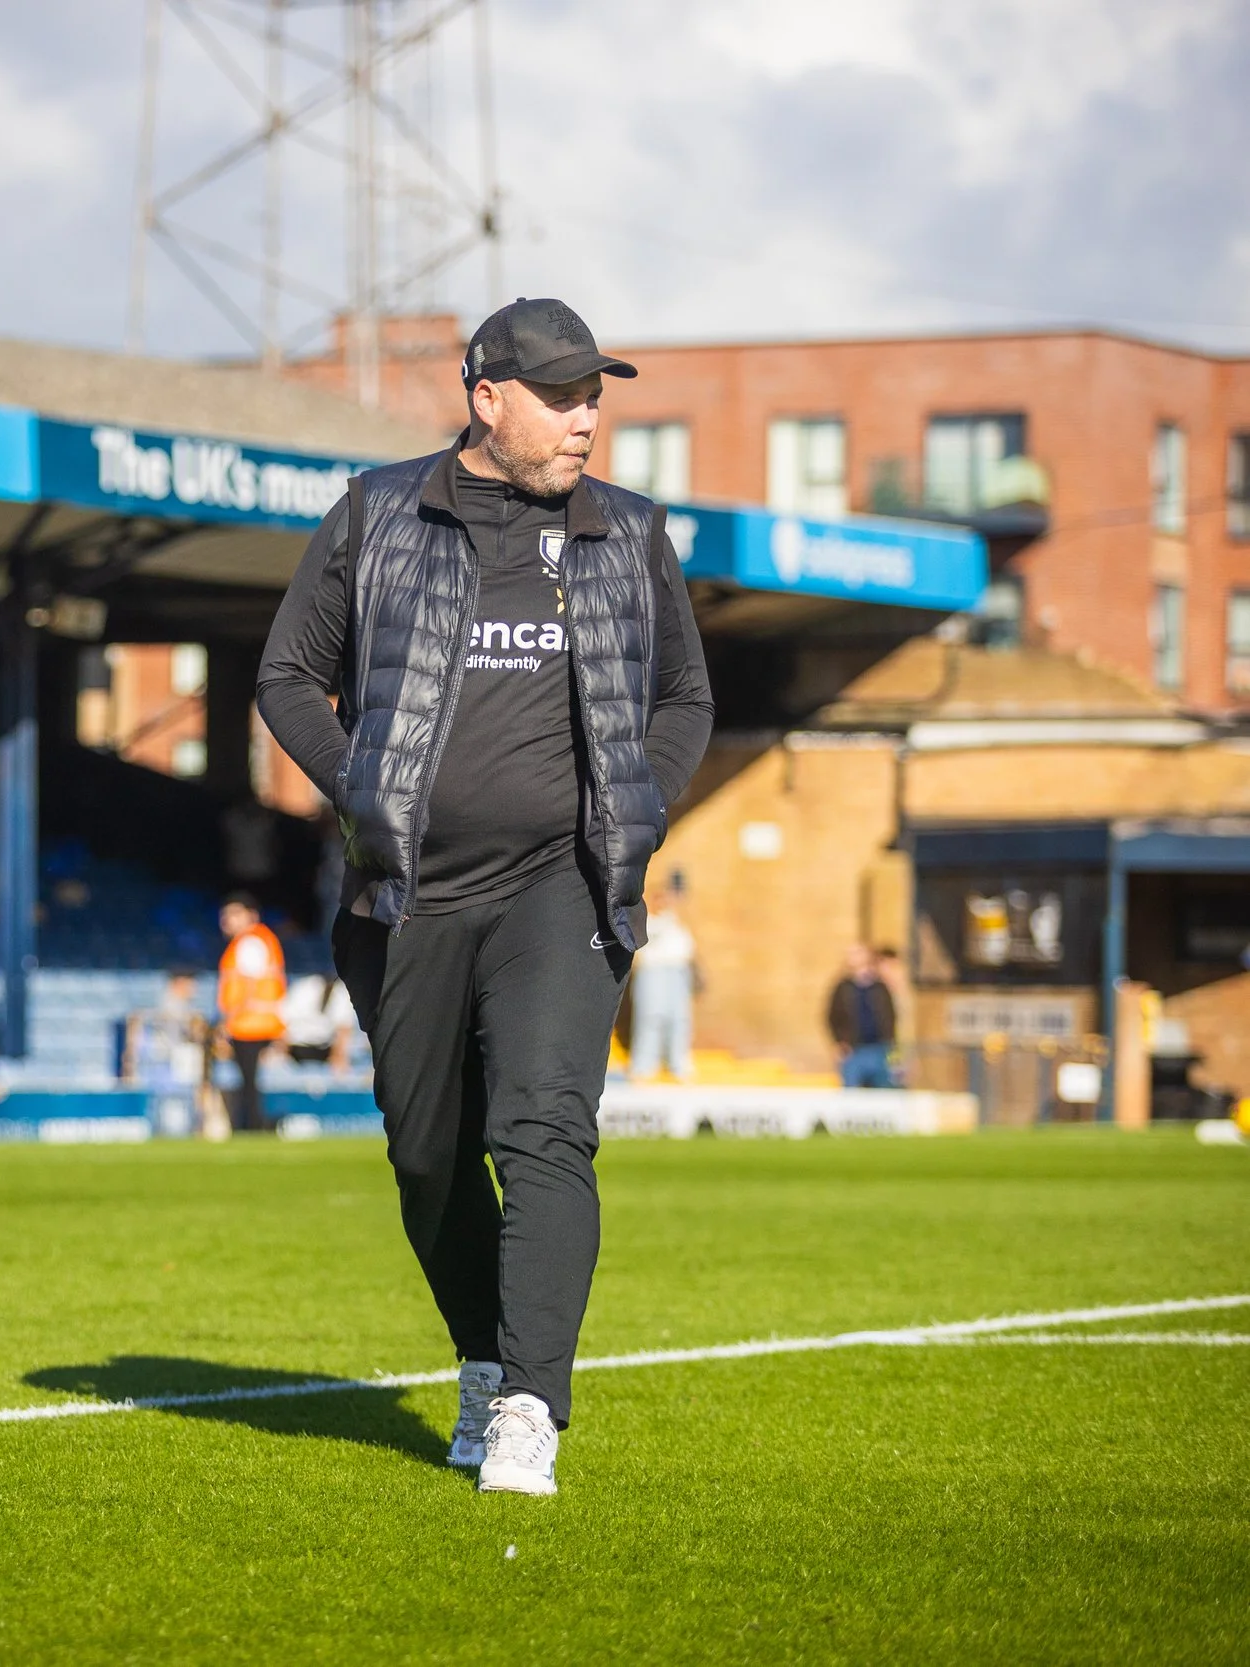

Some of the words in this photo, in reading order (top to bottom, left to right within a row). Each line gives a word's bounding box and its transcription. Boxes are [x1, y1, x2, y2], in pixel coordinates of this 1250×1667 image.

[91, 426, 171, 500] The
[171, 437, 258, 512] UK's
[465, 655, 542, 672] differently
